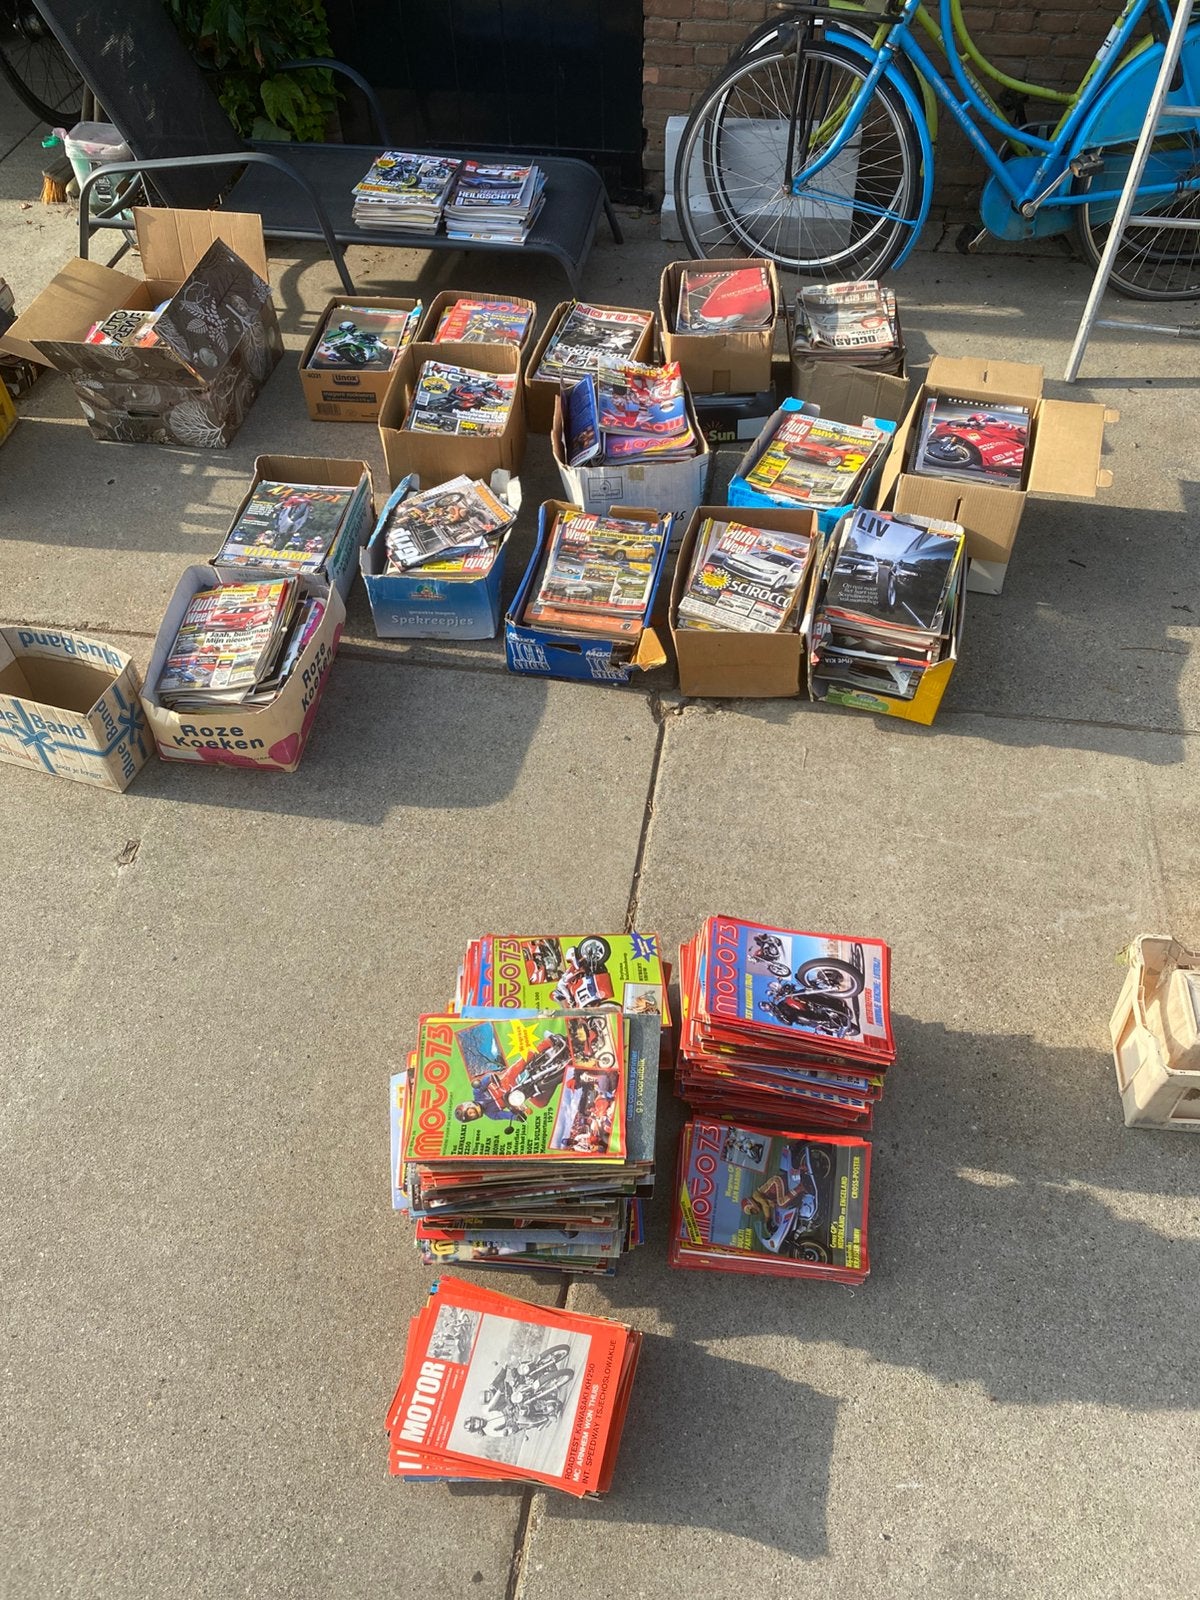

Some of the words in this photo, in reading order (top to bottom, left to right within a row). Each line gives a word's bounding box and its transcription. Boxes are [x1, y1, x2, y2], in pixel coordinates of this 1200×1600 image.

[567, 515, 595, 530] Auto
[856, 512, 890, 538] LIV
[391, 614, 474, 627] Spekreepjes
[18, 631, 77, 655] Band
[76, 640, 122, 669] Blue
[302, 642, 326, 689] Roze
[29, 713, 87, 740] Band
[94, 699, 118, 743] Band
[180, 724, 244, 738] Roze
[118, 742, 136, 779] Blue
[597, 1338, 617, 1419] TSJECHOSLOWAKIJE
[400, 1360, 446, 1443] MOTOR
[590, 1385, 600, 1408] THUIS
[565, 1437, 581, 1480] ROADTEST
[576, 1392, 588, 1435] KAWASAKI
[585, 1363, 595, 1390] KH250
[584, 1409, 594, 1430] WON
[577, 1431, 589, 1467] ARNHEM
[585, 1422, 600, 1466] SPEEDWAY
[573, 1468, 582, 1482] MC
[581, 1468, 592, 1485] INT.
